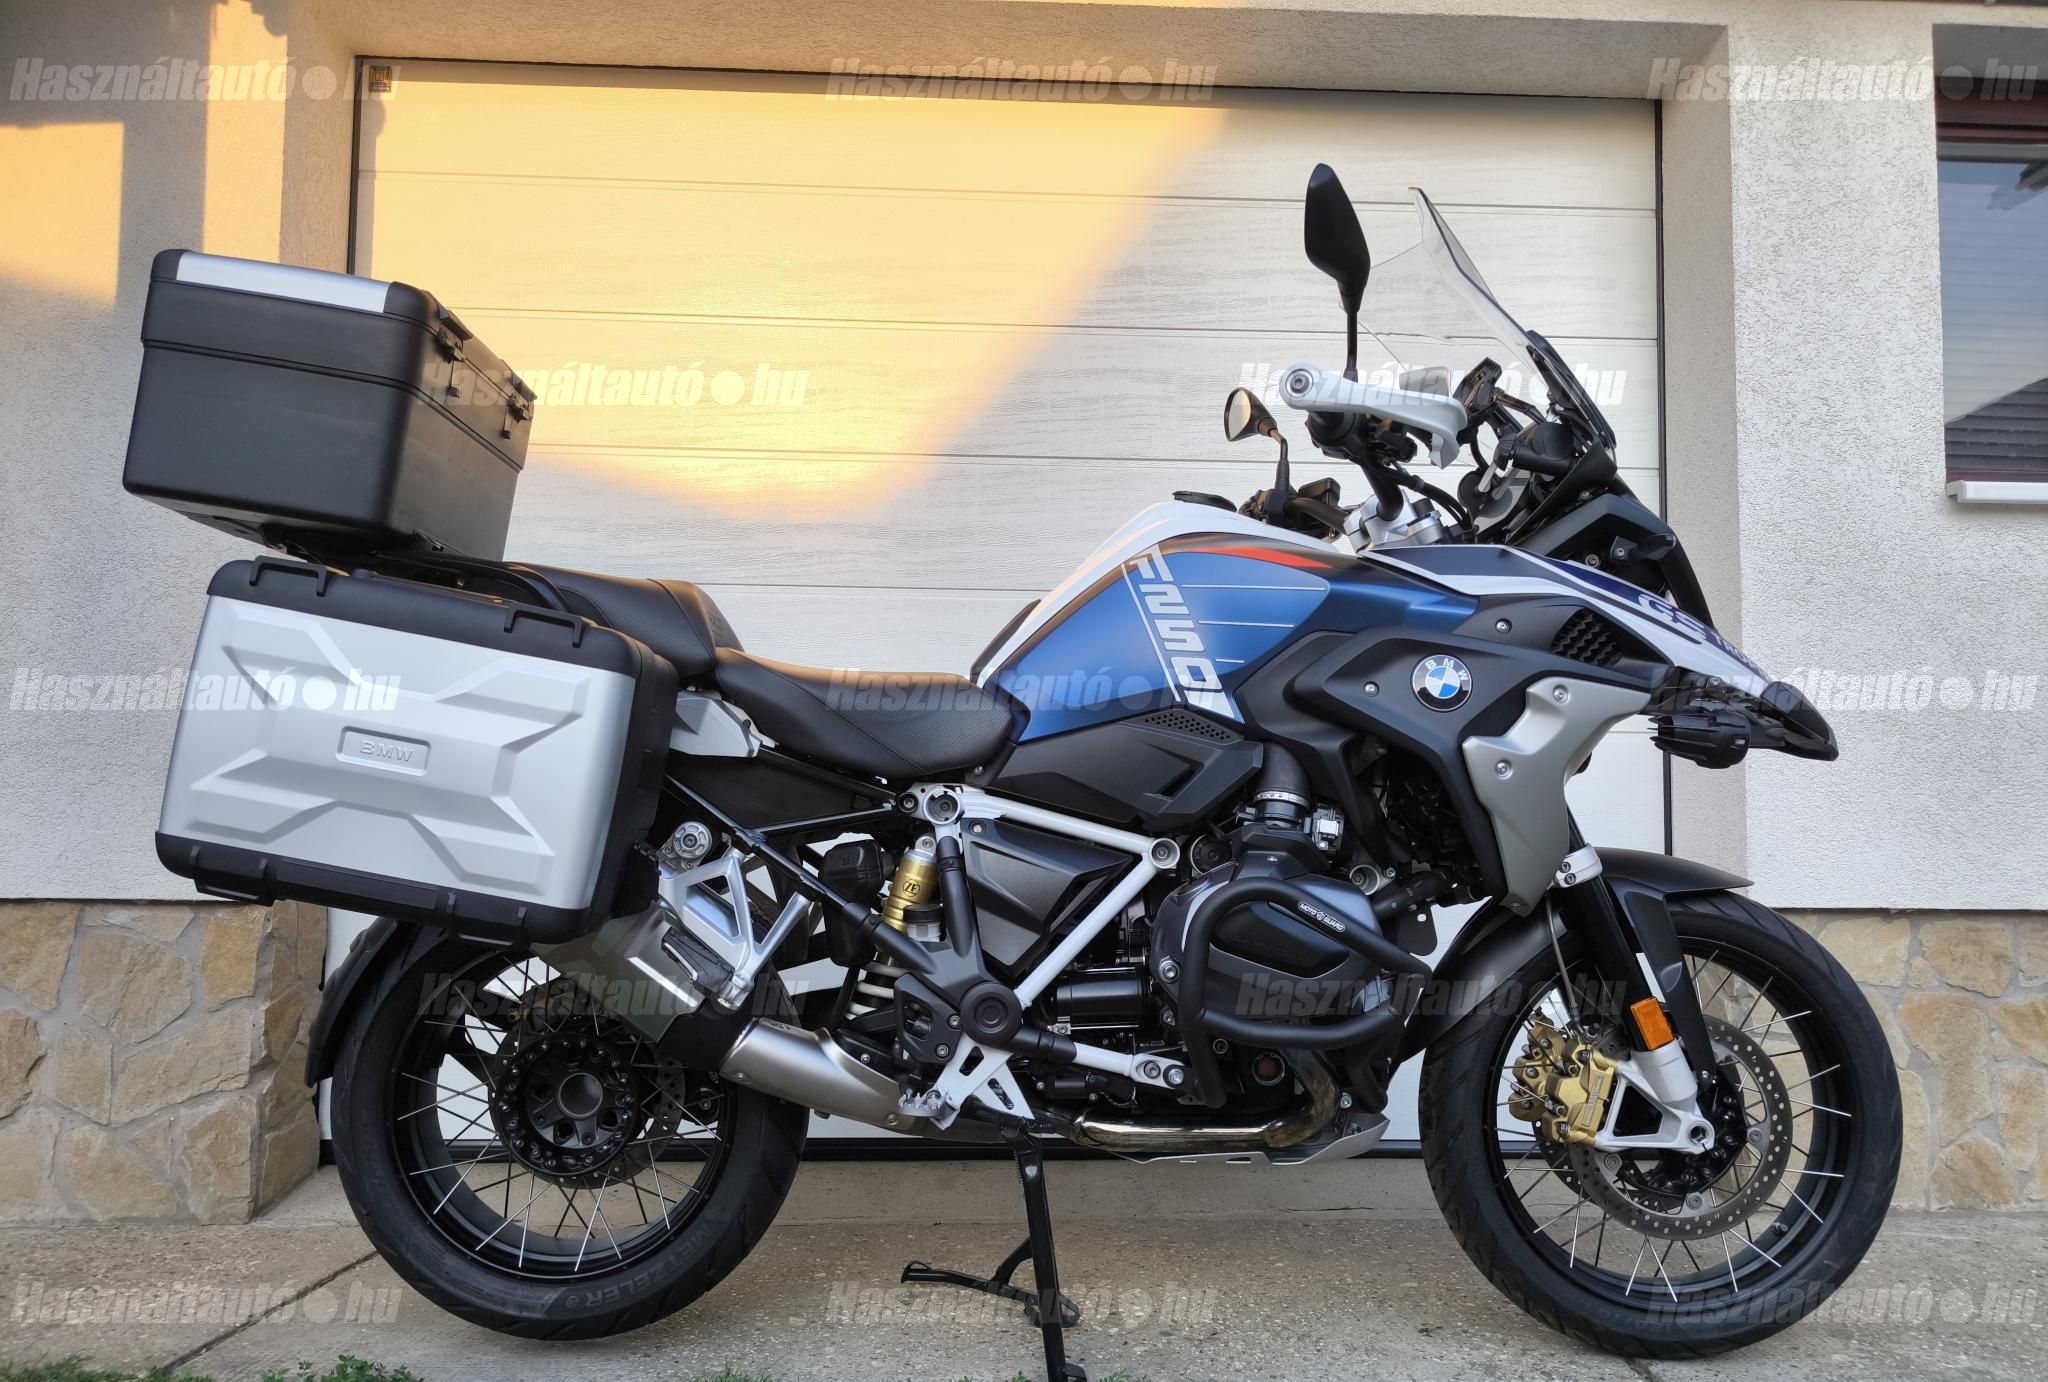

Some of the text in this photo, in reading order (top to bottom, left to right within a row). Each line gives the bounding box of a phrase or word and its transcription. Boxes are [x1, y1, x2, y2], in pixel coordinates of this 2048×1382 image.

[1638, 593, 1707, 641] GS
[1424, 658, 1469, 681] BMW
[359, 740, 415, 762] BMW
[1299, 903, 1345, 931] MOTO GUARD
[585, 1223, 714, 1308] METZELER
